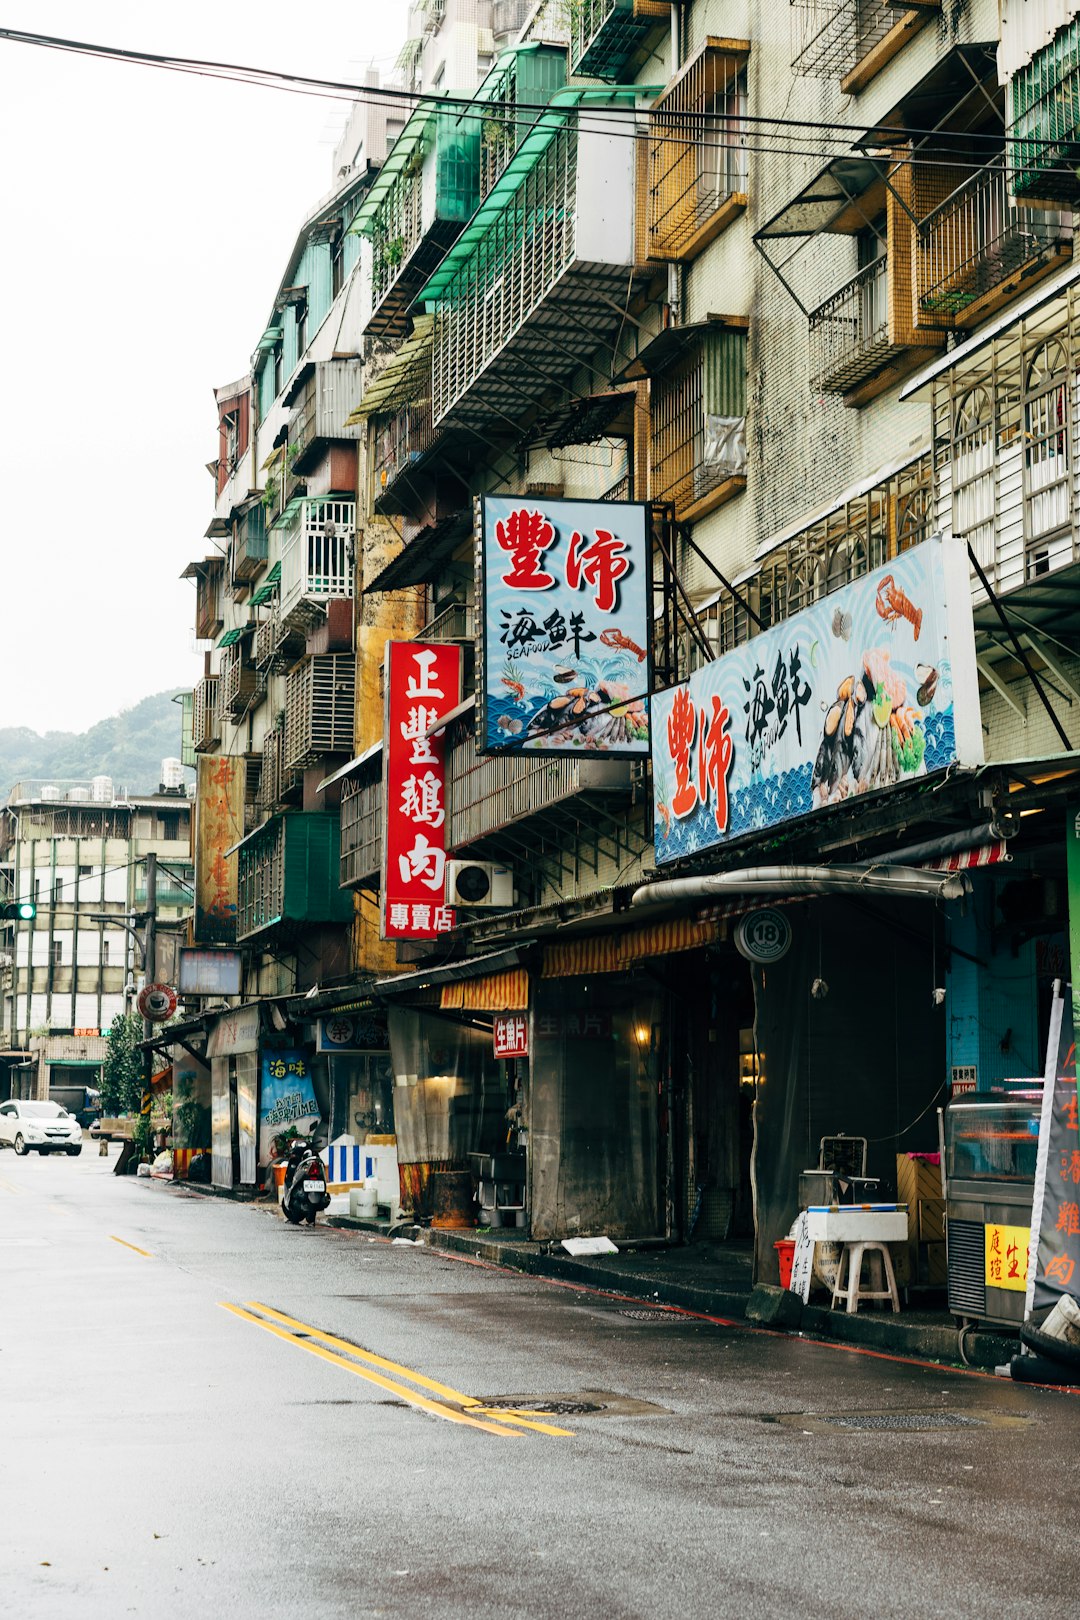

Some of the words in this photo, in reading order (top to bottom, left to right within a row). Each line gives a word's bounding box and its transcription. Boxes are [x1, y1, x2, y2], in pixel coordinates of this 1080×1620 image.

[496, 508, 630, 612] 豐沛
[499, 607, 597, 660] 海鮮
[506, 640, 550, 661] SEAFOOD
[742, 643, 812, 748] 海鮮
[399, 649, 446, 891] 正豐鵝肉
[667, 687, 733, 833] 豐沛
[390, 903, 453, 931] 專賣店
[756, 925, 776, 941] 18
[496, 1018, 524, 1051] 生魚片
[269, 1059, 306, 1078] 海味
[1006, 1236, 1030, 1280] 生
